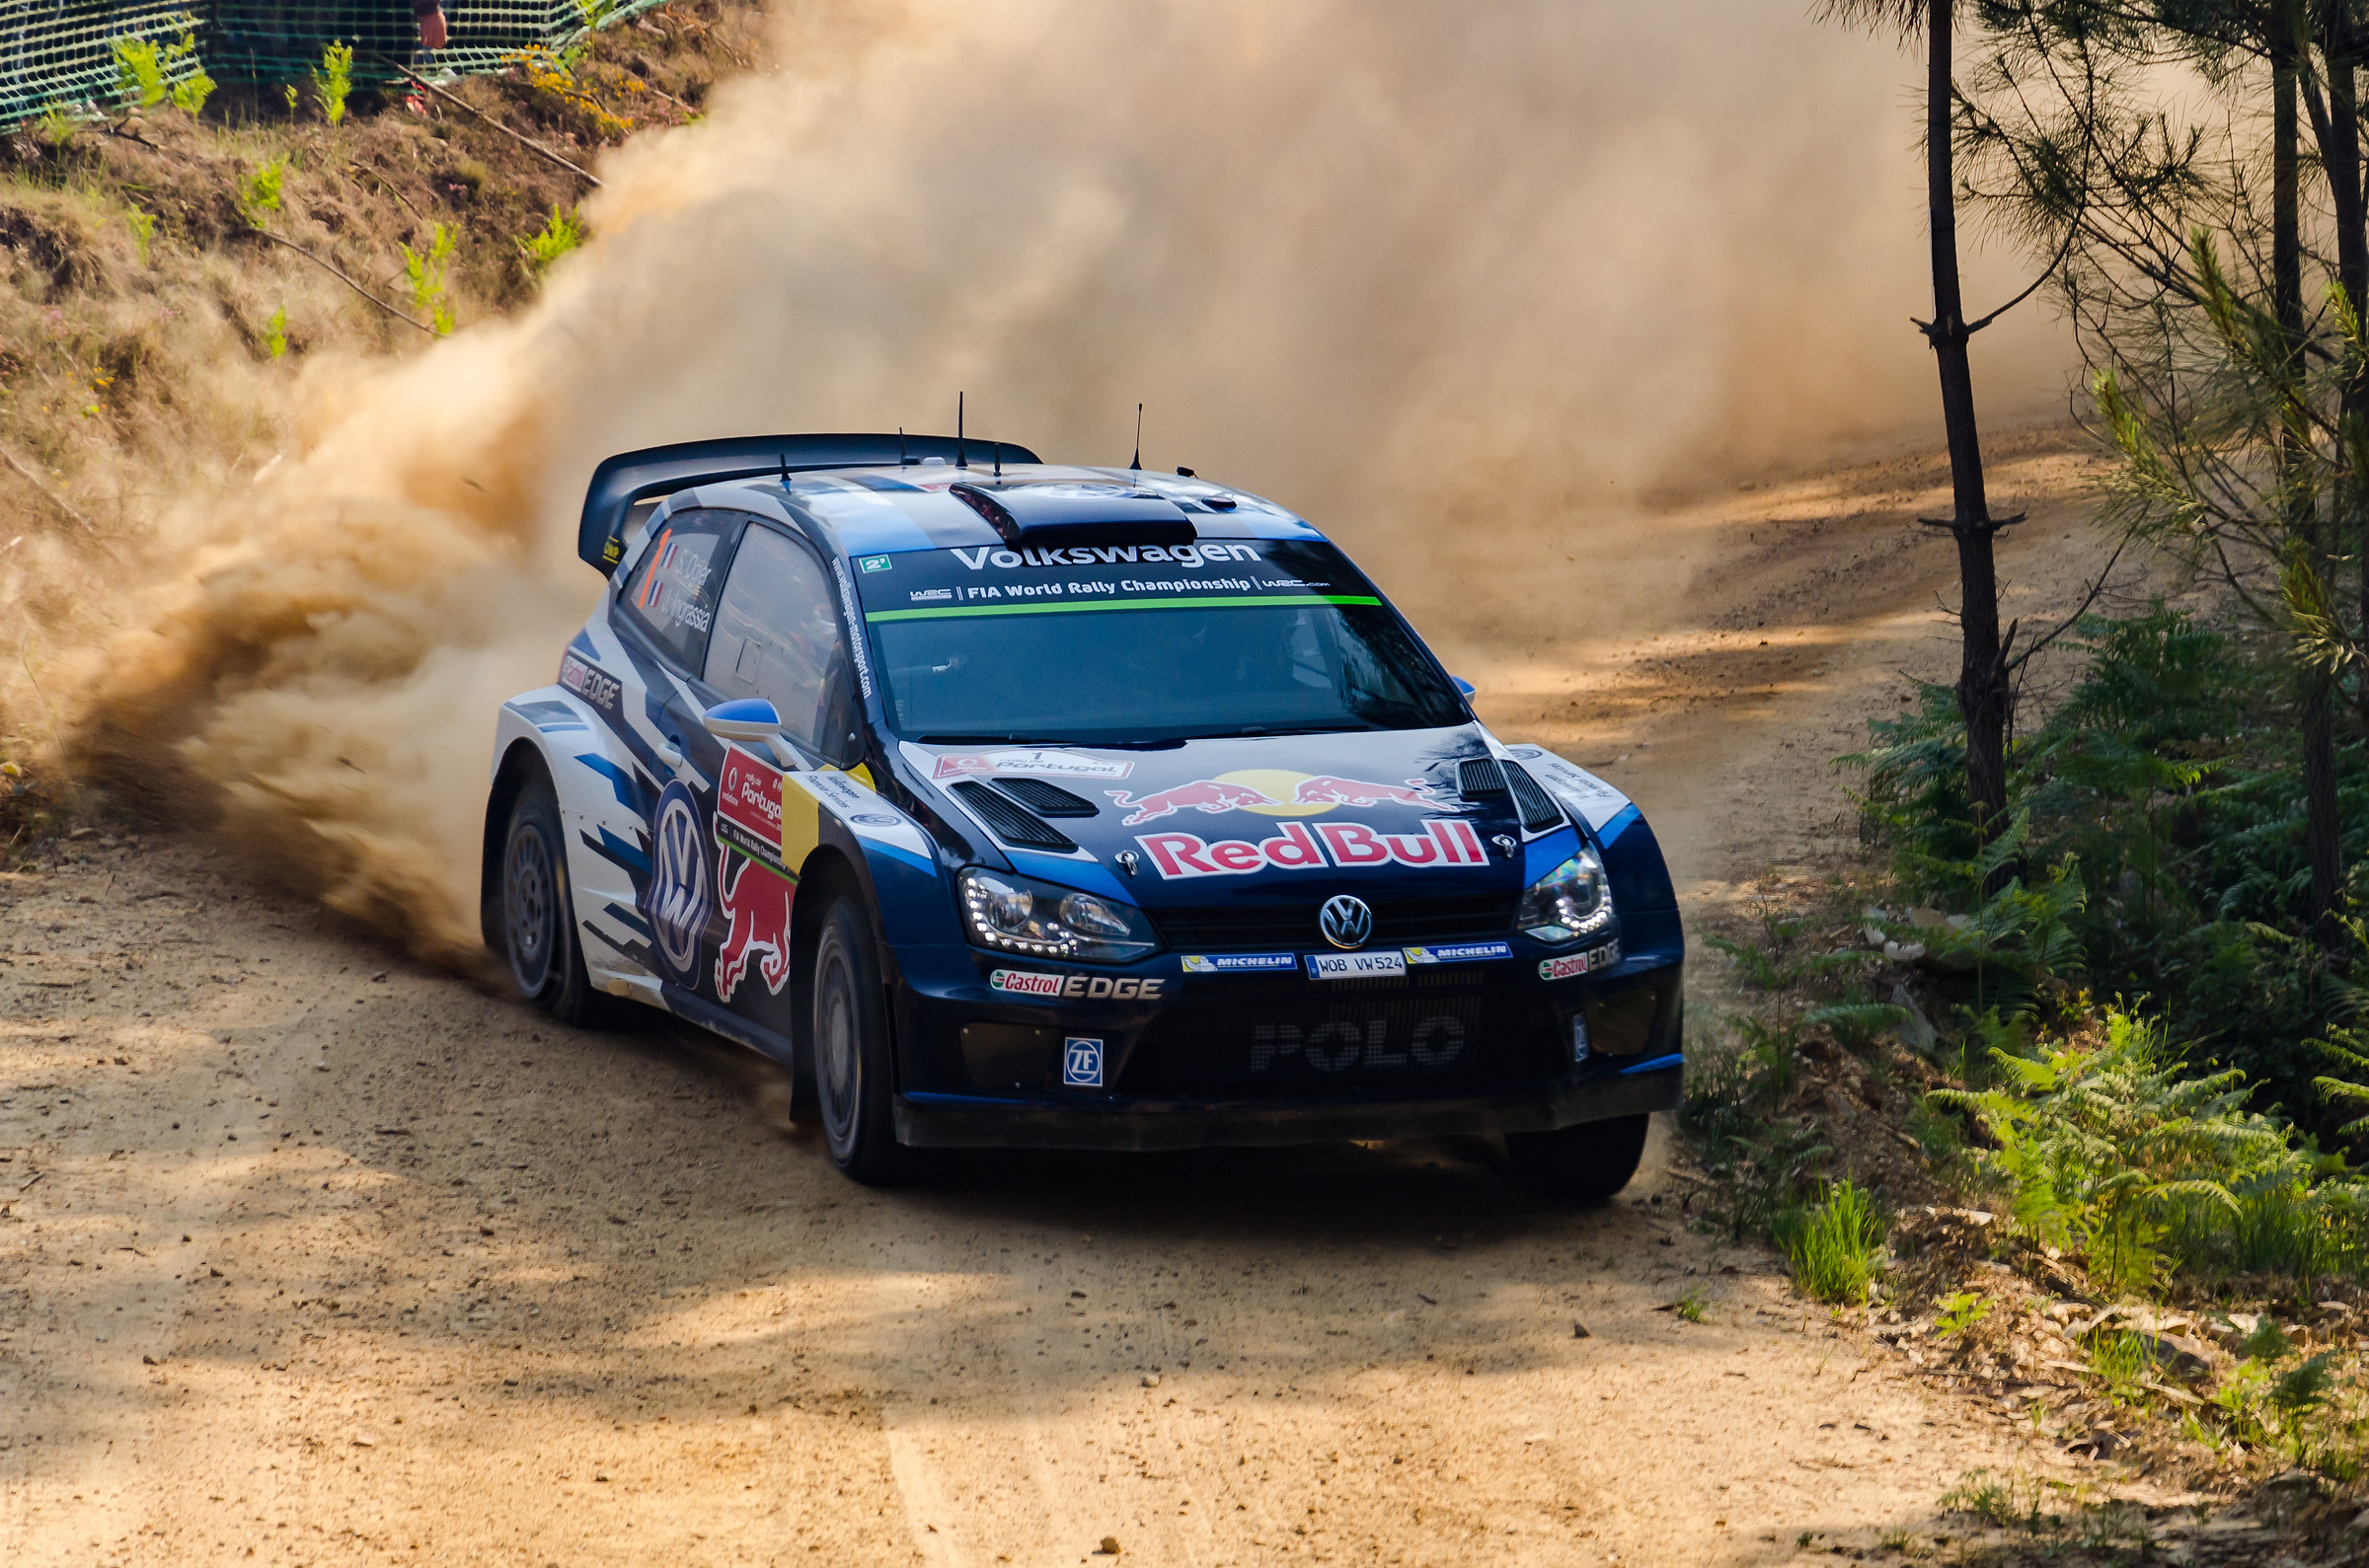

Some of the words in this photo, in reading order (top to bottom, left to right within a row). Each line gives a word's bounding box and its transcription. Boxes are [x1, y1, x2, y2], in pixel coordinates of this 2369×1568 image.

[950, 543, 1261, 570] Volkswagen
[967, 587, 1002, 600] FIA
[1004, 583, 1062, 598] World
[1067, 581, 1115, 594] Rally
[1120, 577, 1252, 592] Championship
[832, 556, 872, 699] www.volkswagen-motorsport.com
[582, 668, 620, 710] EDGE
[996, 759, 1117, 773] Portugal
[741, 782, 782, 820] Portuga
[1138, 823, 1325, 877] Red
[1316, 821, 1486, 865] Bull
[1217, 956, 1292, 967] MICHELIN
[1437, 945, 1506, 957] MICHELIN
[1319, 960, 1347, 972] WOB
[1553, 954, 1587, 978] Castrol
[1005, 972, 1060, 995] Castrol
[1062, 976, 1166, 1000] EDGE
[1250, 1016, 1465, 1072] POLO
[1070, 1047, 1098, 1075] ZF
